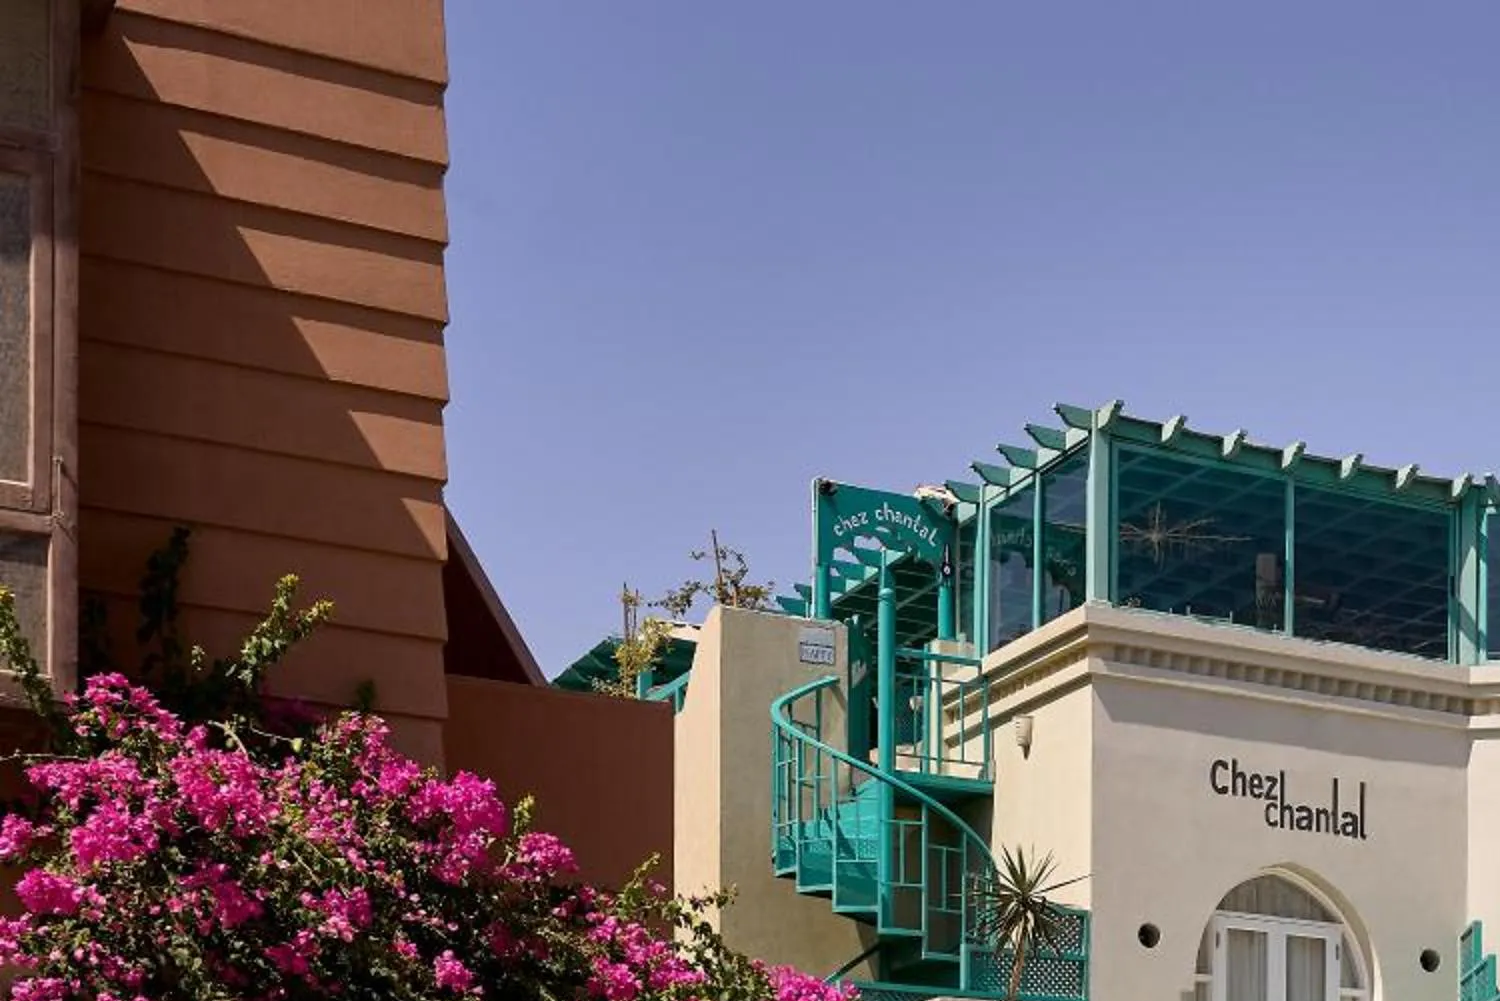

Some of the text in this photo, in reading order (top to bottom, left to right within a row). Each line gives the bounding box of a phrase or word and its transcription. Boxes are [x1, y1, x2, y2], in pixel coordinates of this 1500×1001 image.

[833, 501, 941, 548] chez chantal
[1210, 758, 1279, 801] Chez
